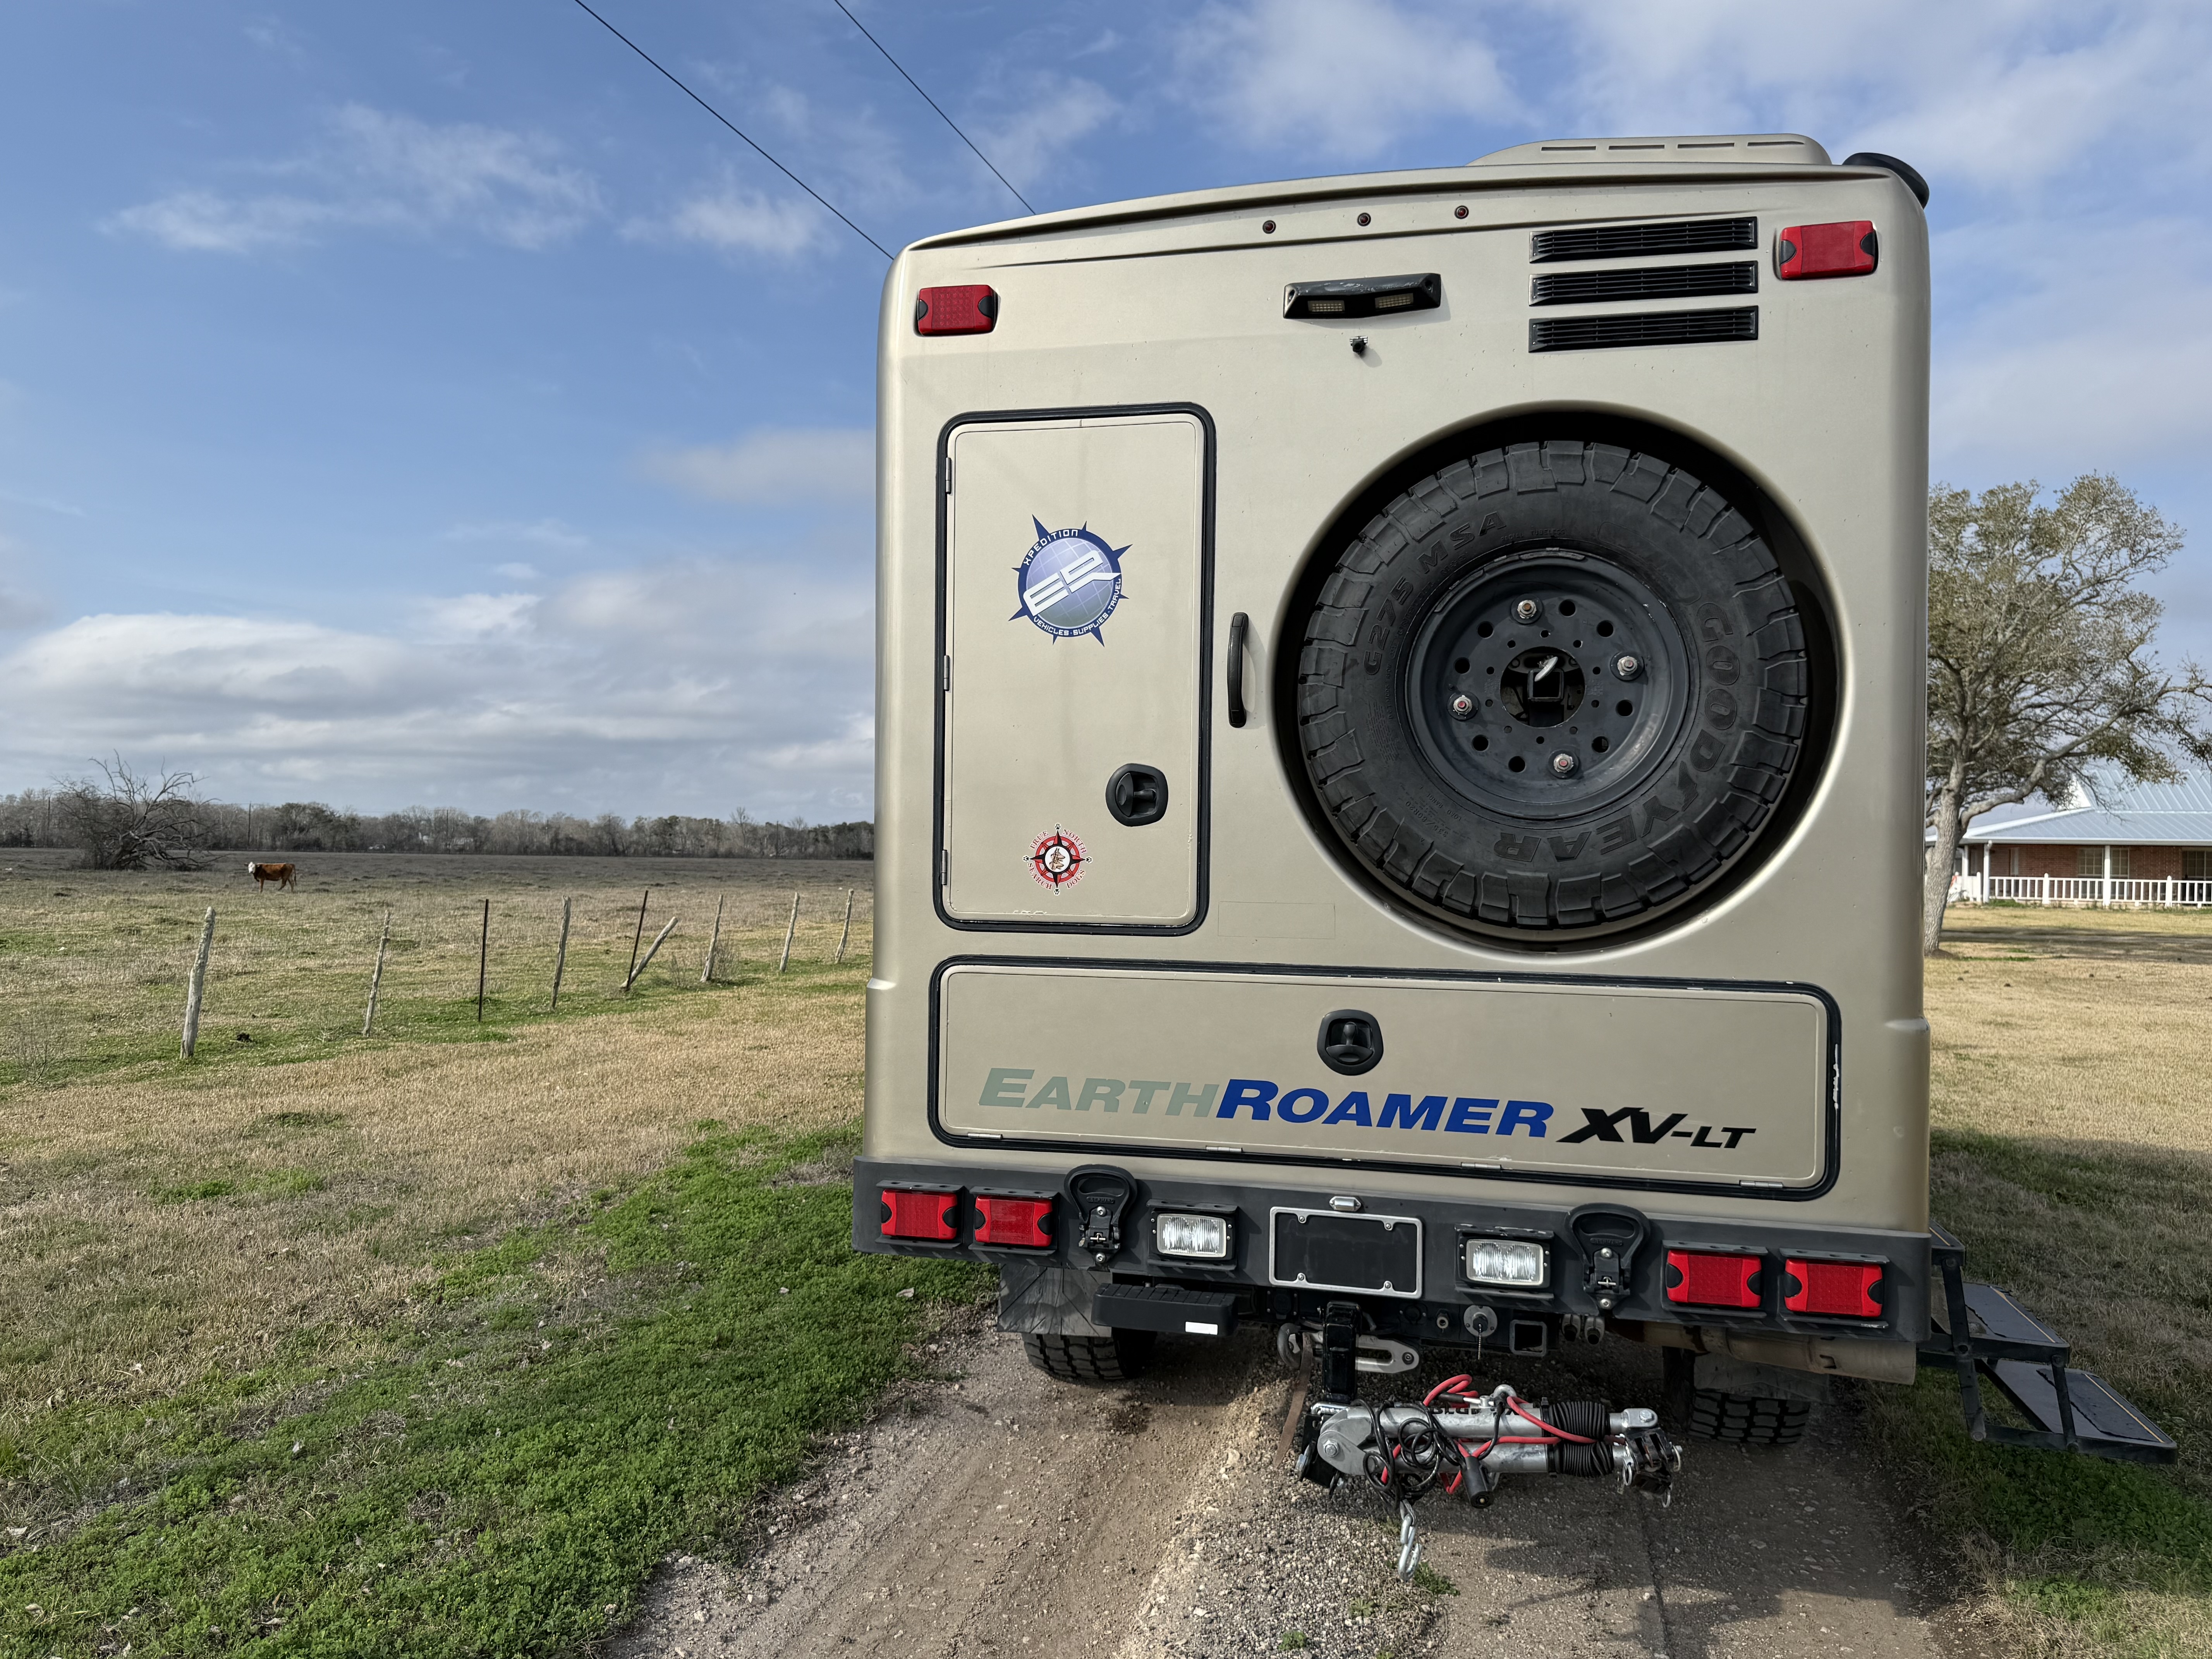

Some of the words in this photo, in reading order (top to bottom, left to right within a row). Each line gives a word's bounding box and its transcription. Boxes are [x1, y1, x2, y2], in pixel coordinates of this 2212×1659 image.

[1023, 529, 1078, 565] XPEDITION
[1034, 617, 1069, 635] VEHICLES
[1073, 612, 1108, 635] SUPPLIES
[1108, 579, 1121, 610] TRAVEL
[1364, 576, 1415, 675] G275
[1417, 512, 1507, 576] MSA
[1494, 602, 1740, 863] GOODYEAR
[1446, 809, 1462, 821] LOAD
[1030, 831, 1048, 849] TRUE
[1063, 830, 1087, 853] NORTH
[1028, 863, 1052, 890] SEARCH
[1067, 870, 1085, 888] DOGS
[1555, 1107, 1756, 1148] XV-LT
